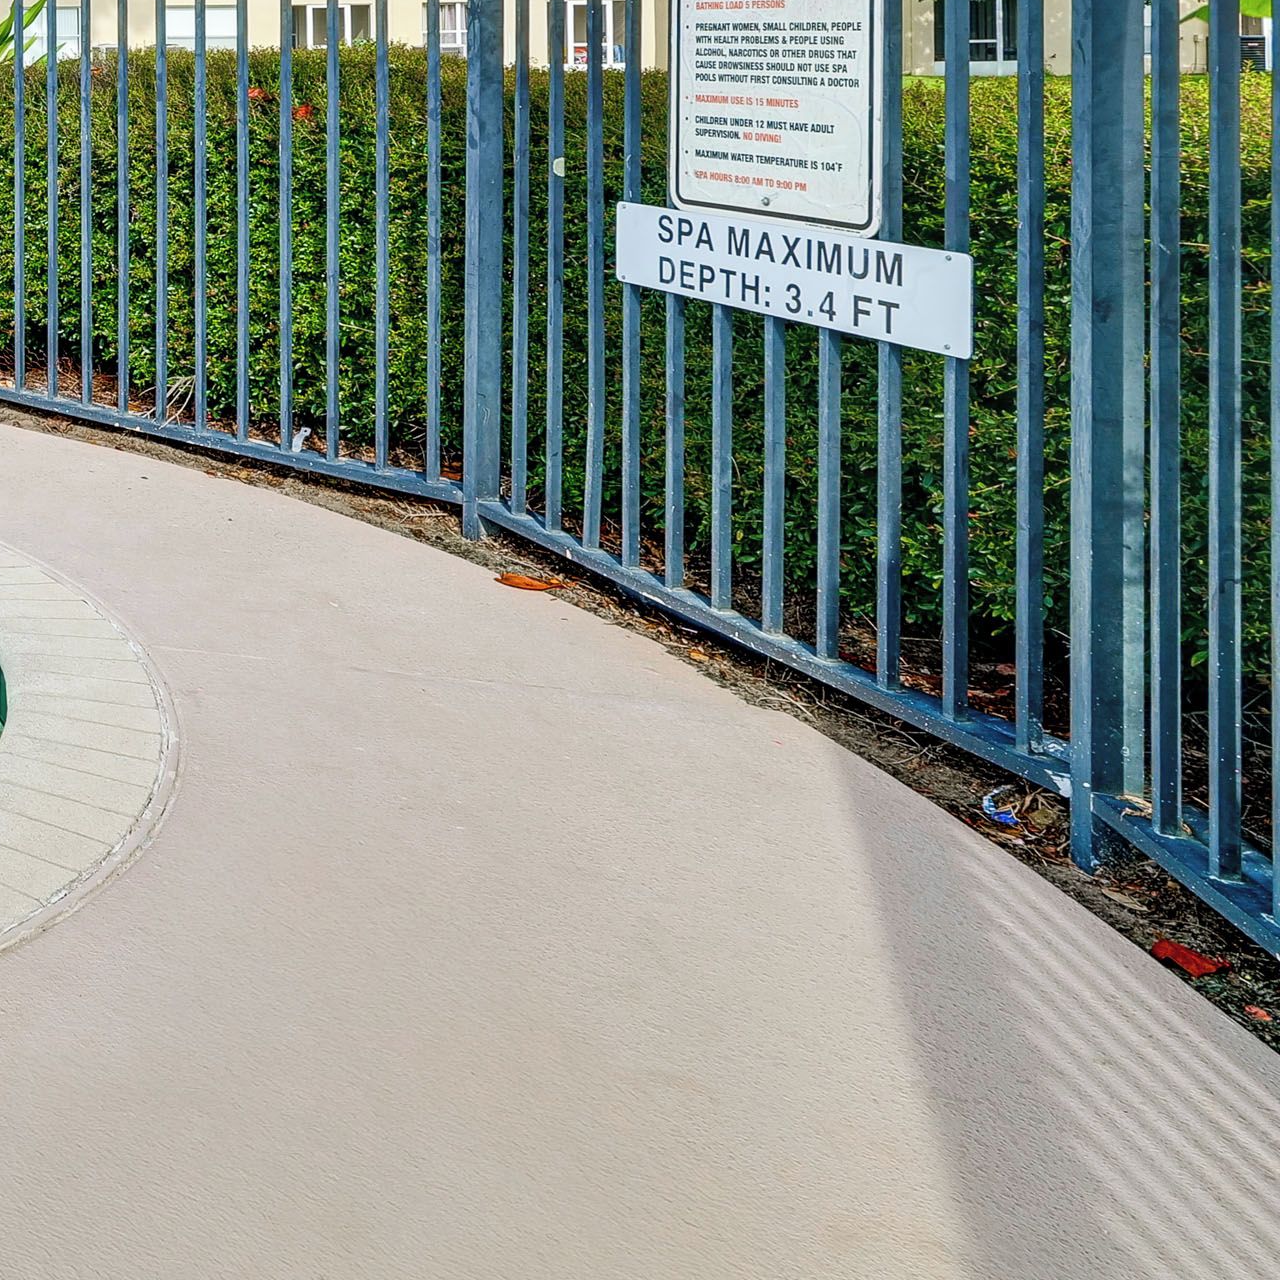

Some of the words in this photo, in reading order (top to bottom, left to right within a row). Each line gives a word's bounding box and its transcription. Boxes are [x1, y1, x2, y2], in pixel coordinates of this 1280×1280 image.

[696, 1, 724, 10] BATHING
[725, 1, 744, 9] LOAD
[745, 1, 750, 9] 5
[752, 0, 786, 9] PERSONS
[695, 23, 731, 31] PREGNANT
[762, 23, 787, 31] SMALL
[831, 22, 862, 31] PEOPLE
[695, 36, 712, 44] WITH
[713, 36, 739, 44] HEALTH
[740, 36, 779, 44] PROBLEMS
[781, 36, 787, 44] &
[789, 36, 818, 45] PEOPLE
[820, 36, 845, 45] USING
[728, 49, 768, 58] NARCOTICS
[770, 49, 780, 58] OR
[782, 49, 806, 58] OTHER
[808, 49, 835, 59] DRUGS
[837, 50, 857, 59] THAT
[695, 61, 717, 69] CAUSE
[718, 61, 764, 71] DROWSINESS
[766, 62, 795, 71] SHOULD
[797, 63, 812, 72] NOT
[814, 64, 830, 73] USE
[832, 64, 848, 73] SPA
[695, 74, 716, 82] POOLS
[718, 74, 749, 83] WITHOUT
[750, 75, 771, 84] FIRST
[772, 76, 818, 86] CONSULTING
[819, 78, 825, 86] A
[827, 78, 860, 88] DOCTOR
[695, 95, 729, 104] MAXIMUM
[730, 96, 744, 105] USE
[746, 97, 753, 105] IS
[755, 97, 764, 106] 15
[766, 98, 799, 109] MINUTES
[695, 115, 728, 126] CHILDREN
[730, 117, 753, 128] UNDER
[755, 119, 764, 128] 12
[766, 120, 788, 130] MUST
[790, 122, 809, 132] HAVE
[810, 124, 834, 134] ADULT
[743, 132, 753, 141] NO
[755, 133, 782, 143] DIVING!
[695, 149, 729, 160] MAXIMUM
[730, 152, 754, 163] WATER
[755, 155, 809, 169] TEMPERATURE
[810, 161, 818, 170] IS
[695, 170, 708, 180] SPA
[709, 171, 733, 182] HOURS
[735, 175, 751, 184] 8:00
[752, 177, 763, 186] AM
[765, 178, 774, 187] TO
[776, 180, 793, 190] 9:00
[794, 182, 806, 192] PM
[658, 214, 714, 252] SPA
[727, 226, 904, 287] MAXIMUM
[659, 256, 771, 307] DEPTH:
[785, 284, 836, 323] 3.4
[853, 295, 900, 335] FT
